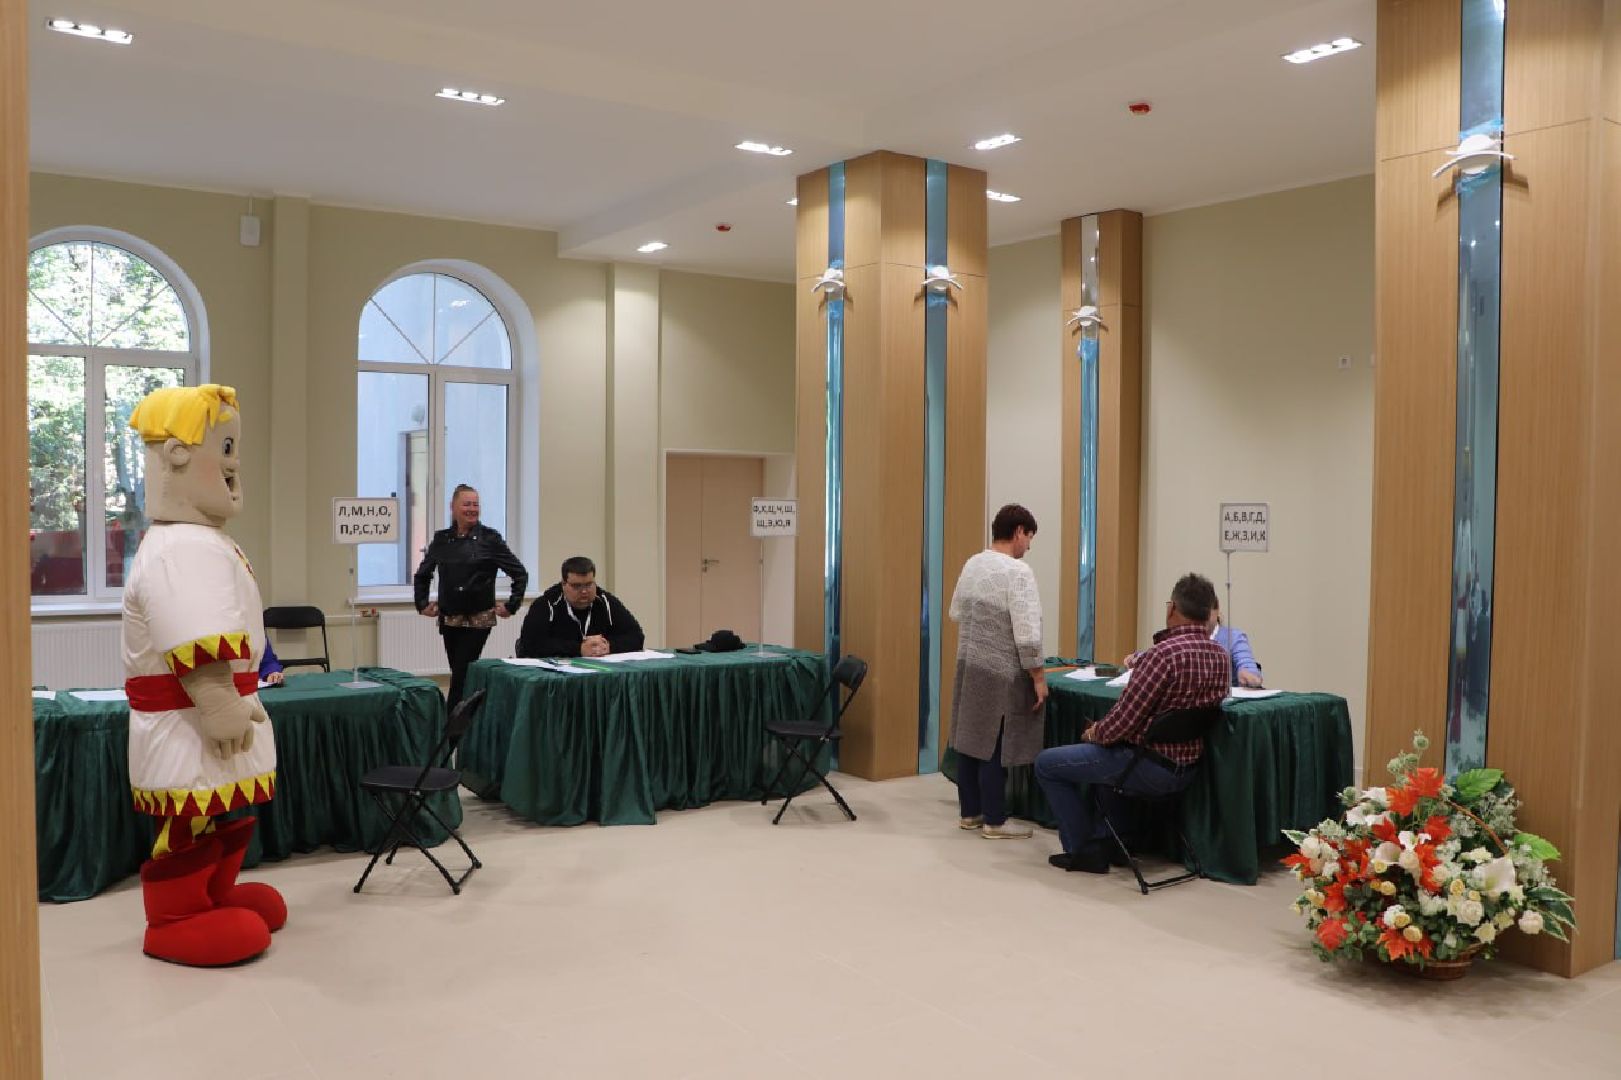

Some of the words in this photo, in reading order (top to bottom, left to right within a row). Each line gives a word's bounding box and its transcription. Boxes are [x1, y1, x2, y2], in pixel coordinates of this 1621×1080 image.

[338, 505, 392, 517] Л,М,Н,О,
[340, 523, 391, 535] П,Р,С,Т,У
[1224, 530, 1266, 543] Е,Ж,З,И,К
